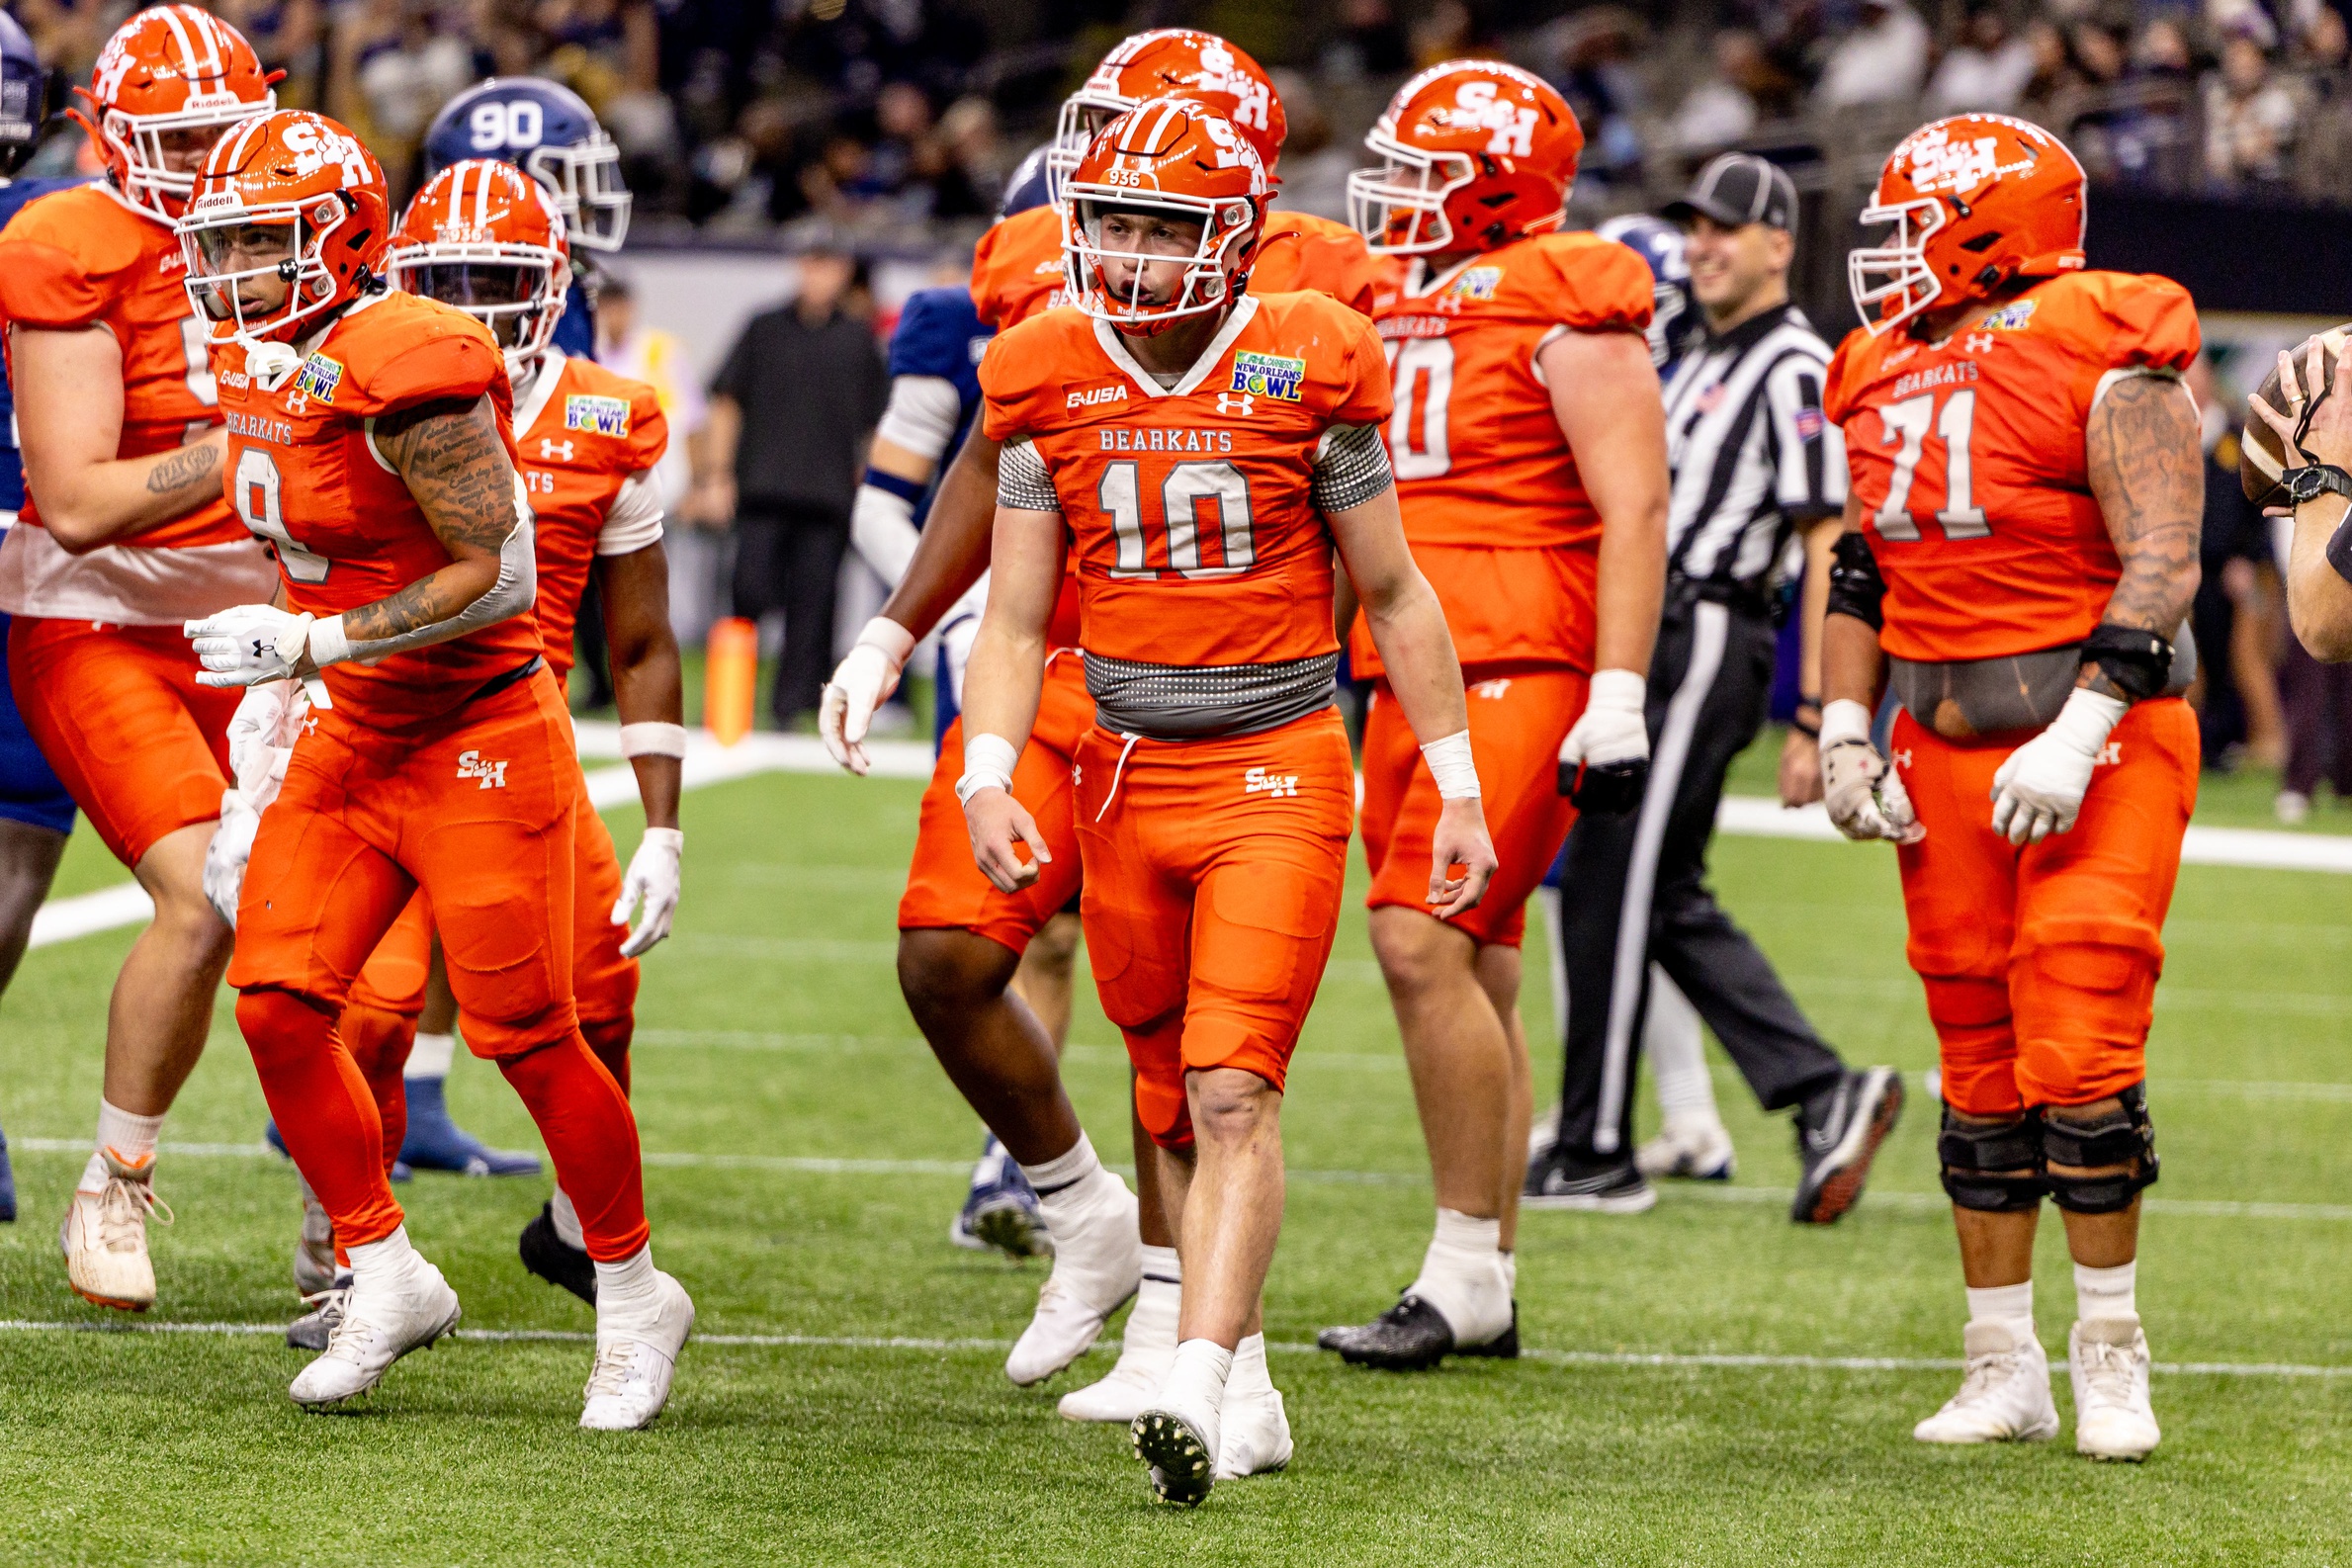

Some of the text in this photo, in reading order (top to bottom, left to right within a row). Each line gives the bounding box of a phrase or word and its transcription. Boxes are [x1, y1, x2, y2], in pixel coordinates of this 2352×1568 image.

[192, 98, 234, 110] Riddell
[470, 101, 543, 151] 90
[1108, 170, 1141, 187] 936
[198, 196, 233, 210] Riddell
[448, 228, 482, 242] 936
[1116, 305, 1149, 317] Ridell
[1235, 362, 1302, 381] NEW ORLEANS
[1892, 361, 1979, 398] BEARKATS
[296, 369, 333, 402] BOWL
[1232, 371, 1299, 399] BOWL
[227, 411, 293, 446] BEARKATS
[567, 412, 626, 435] BOWL
[1099, 429, 1233, 453] BEARKATS
[1873, 378, 1993, 542] 71
[234, 444, 331, 585] 9
[1097, 459, 1258, 580] 10
